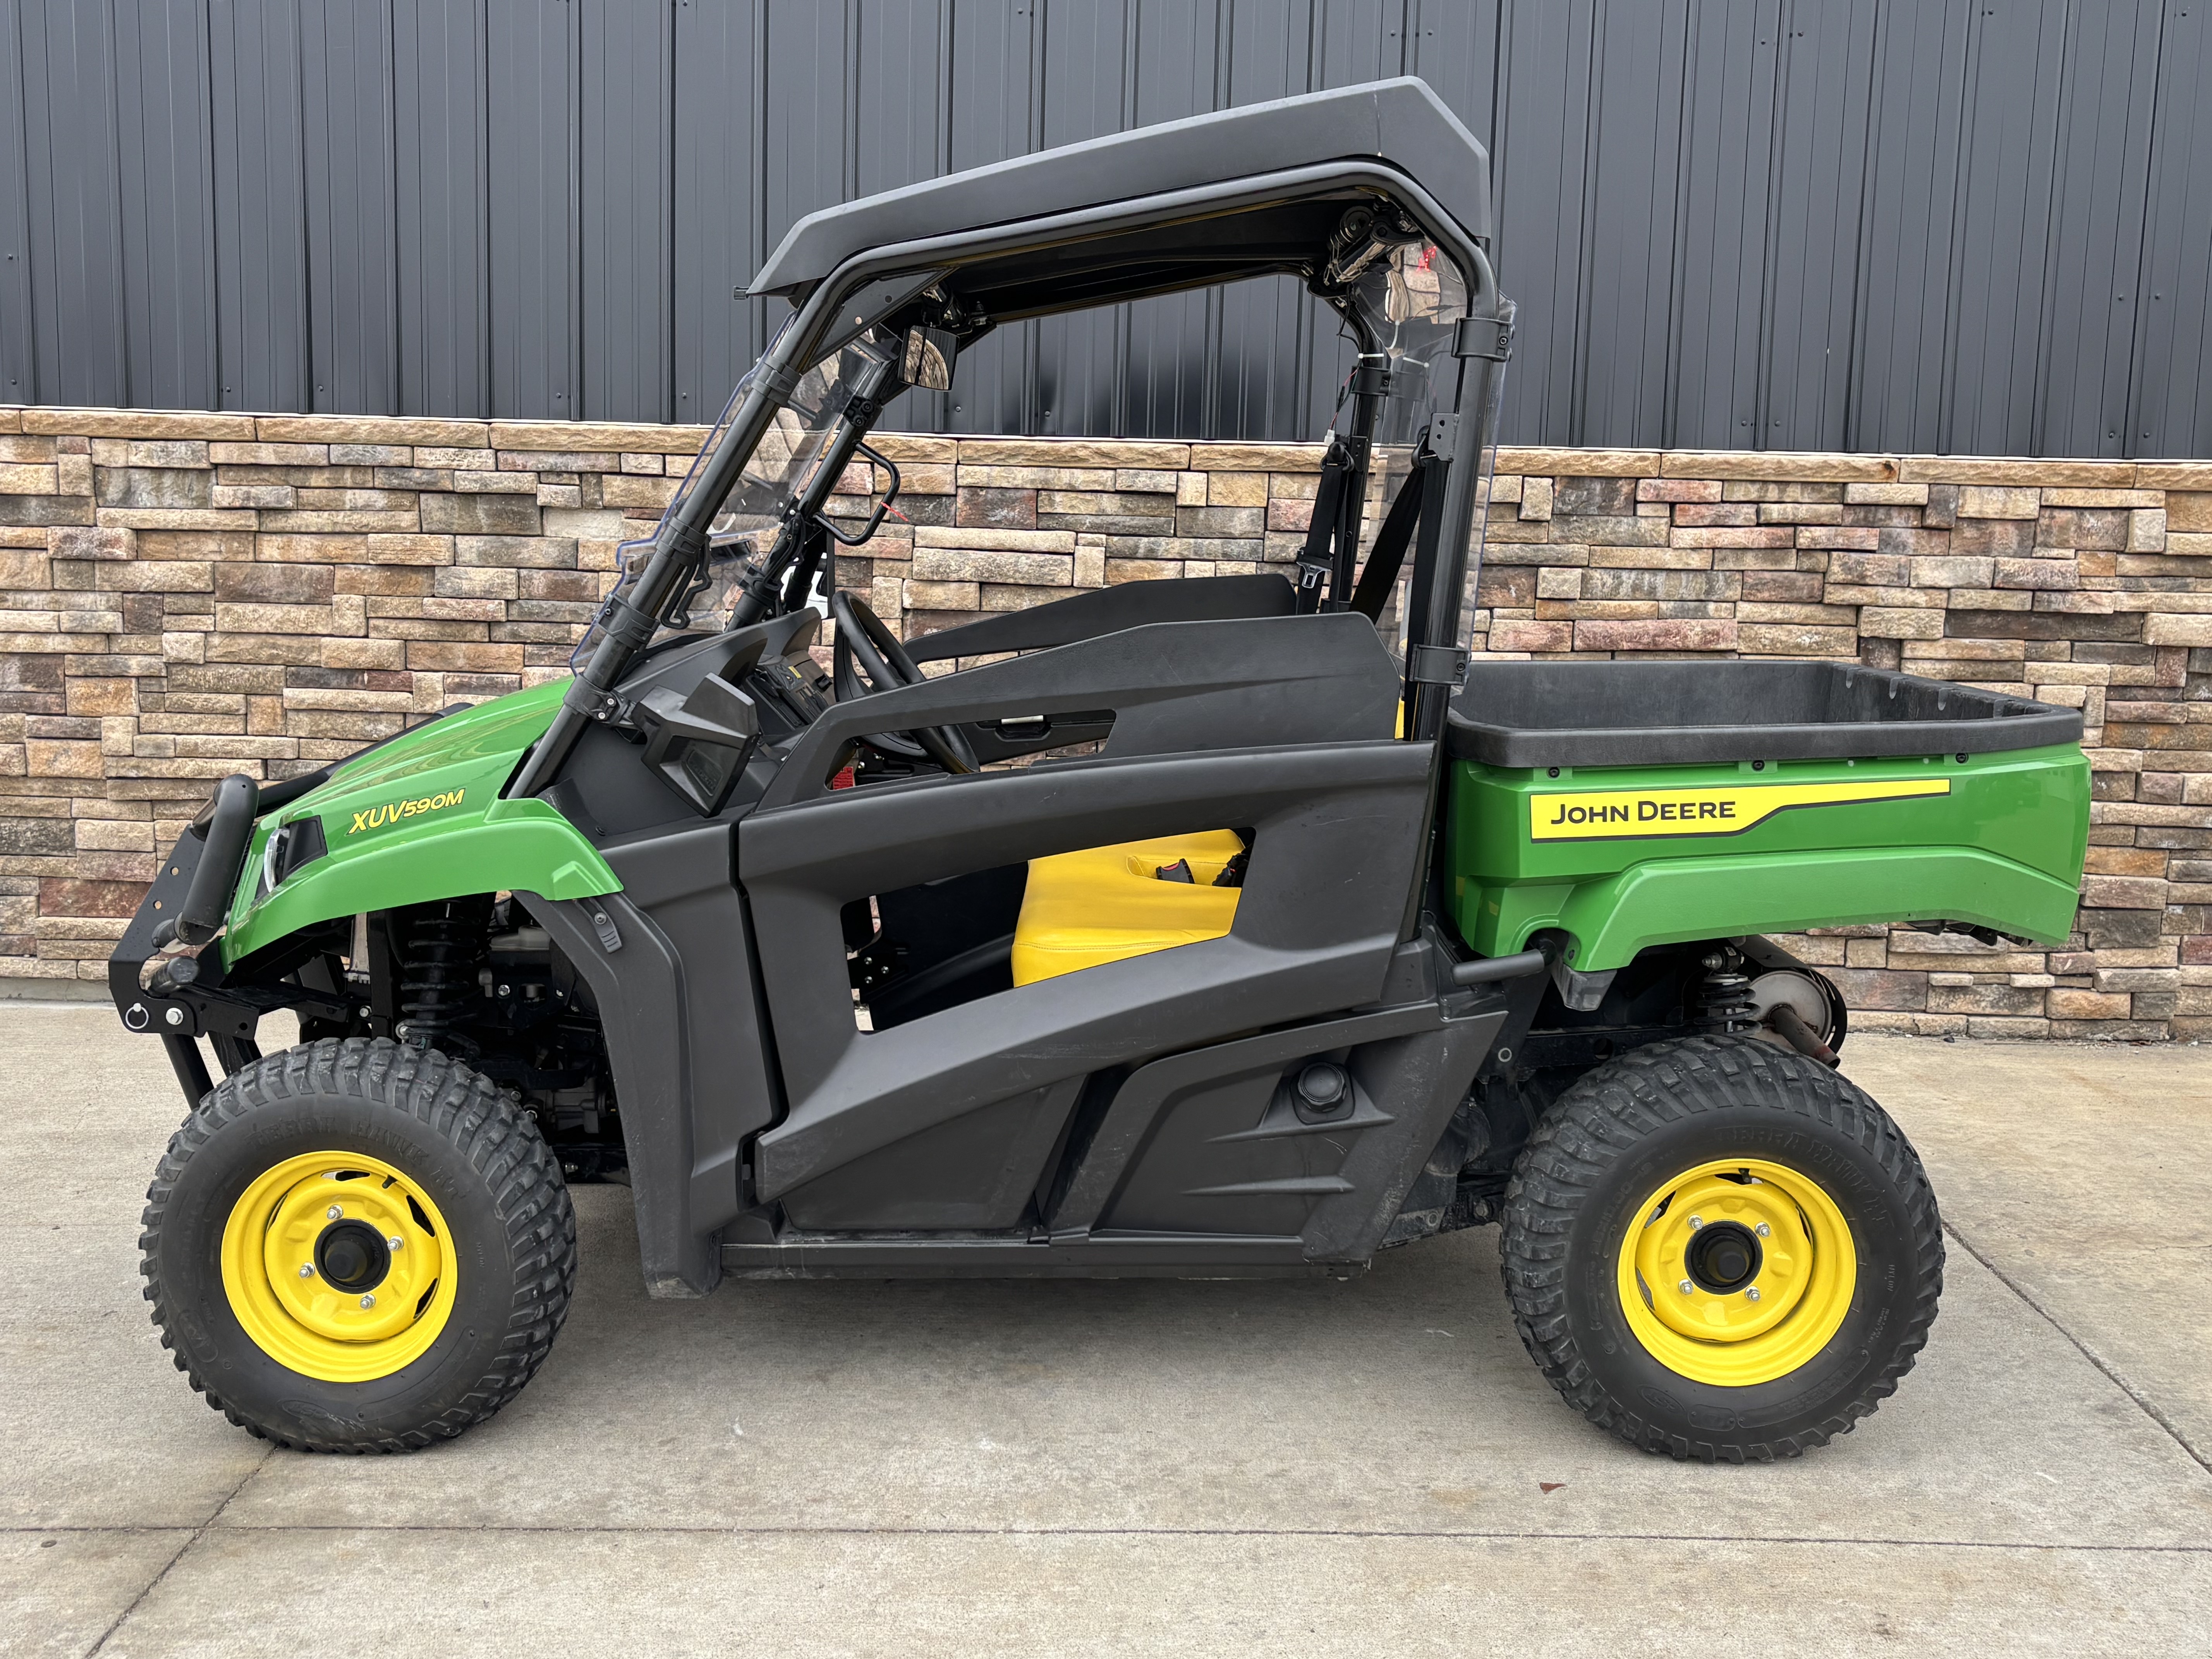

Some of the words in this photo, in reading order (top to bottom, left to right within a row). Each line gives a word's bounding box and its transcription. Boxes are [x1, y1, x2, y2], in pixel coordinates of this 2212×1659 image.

[347, 788, 465, 835] XUV590M
[1551, 804, 1629, 825] JOHN
[1638, 800, 1736, 821] DEERE
